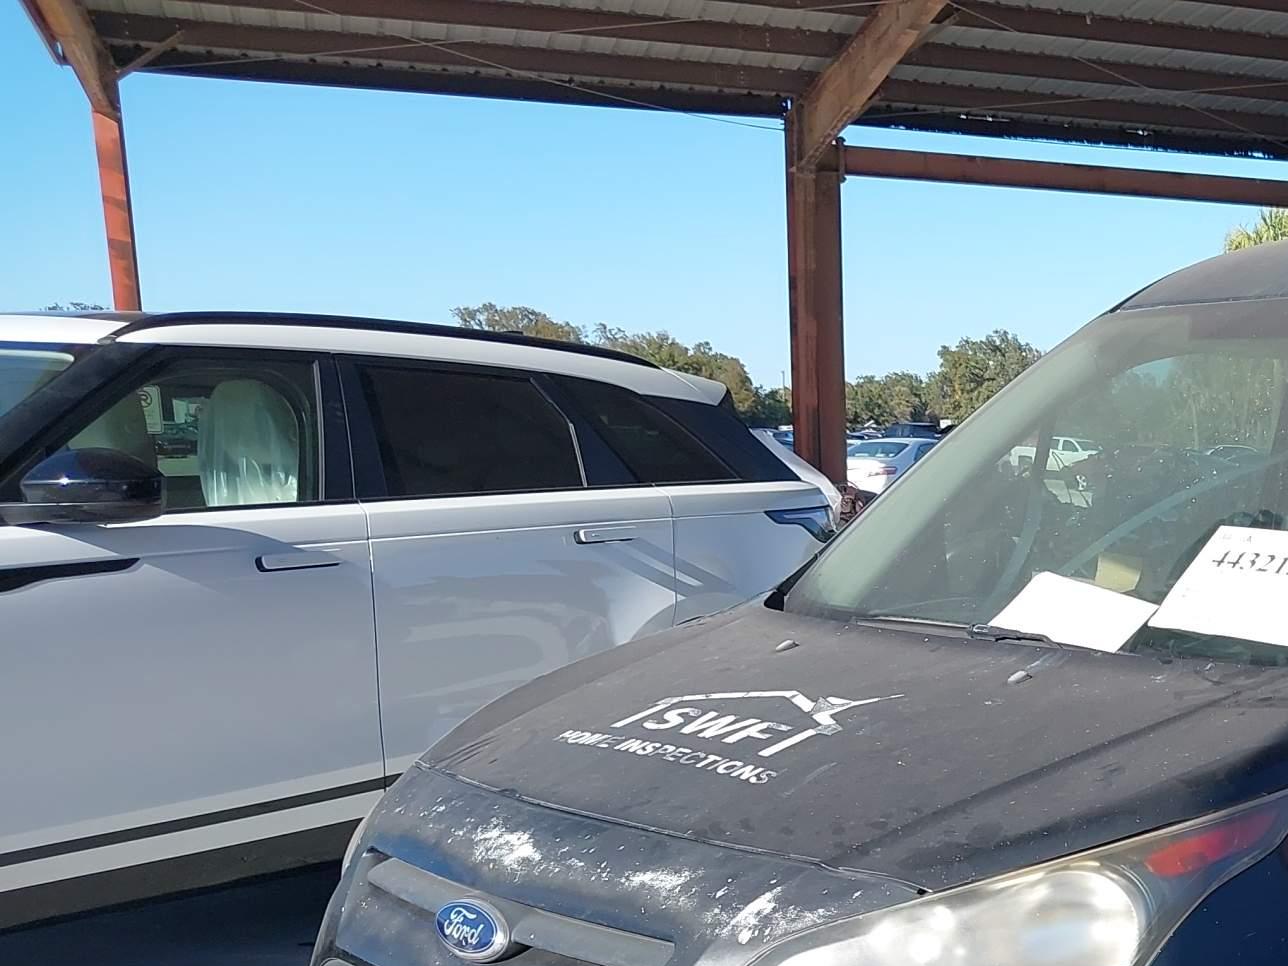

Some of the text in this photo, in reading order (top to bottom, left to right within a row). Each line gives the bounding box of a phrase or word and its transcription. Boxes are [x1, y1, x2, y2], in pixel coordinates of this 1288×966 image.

[642, 707, 792, 744] SWF
[556, 729, 778, 784] HOME INSPECTIONS
[443, 907, 485, 946] Ford
